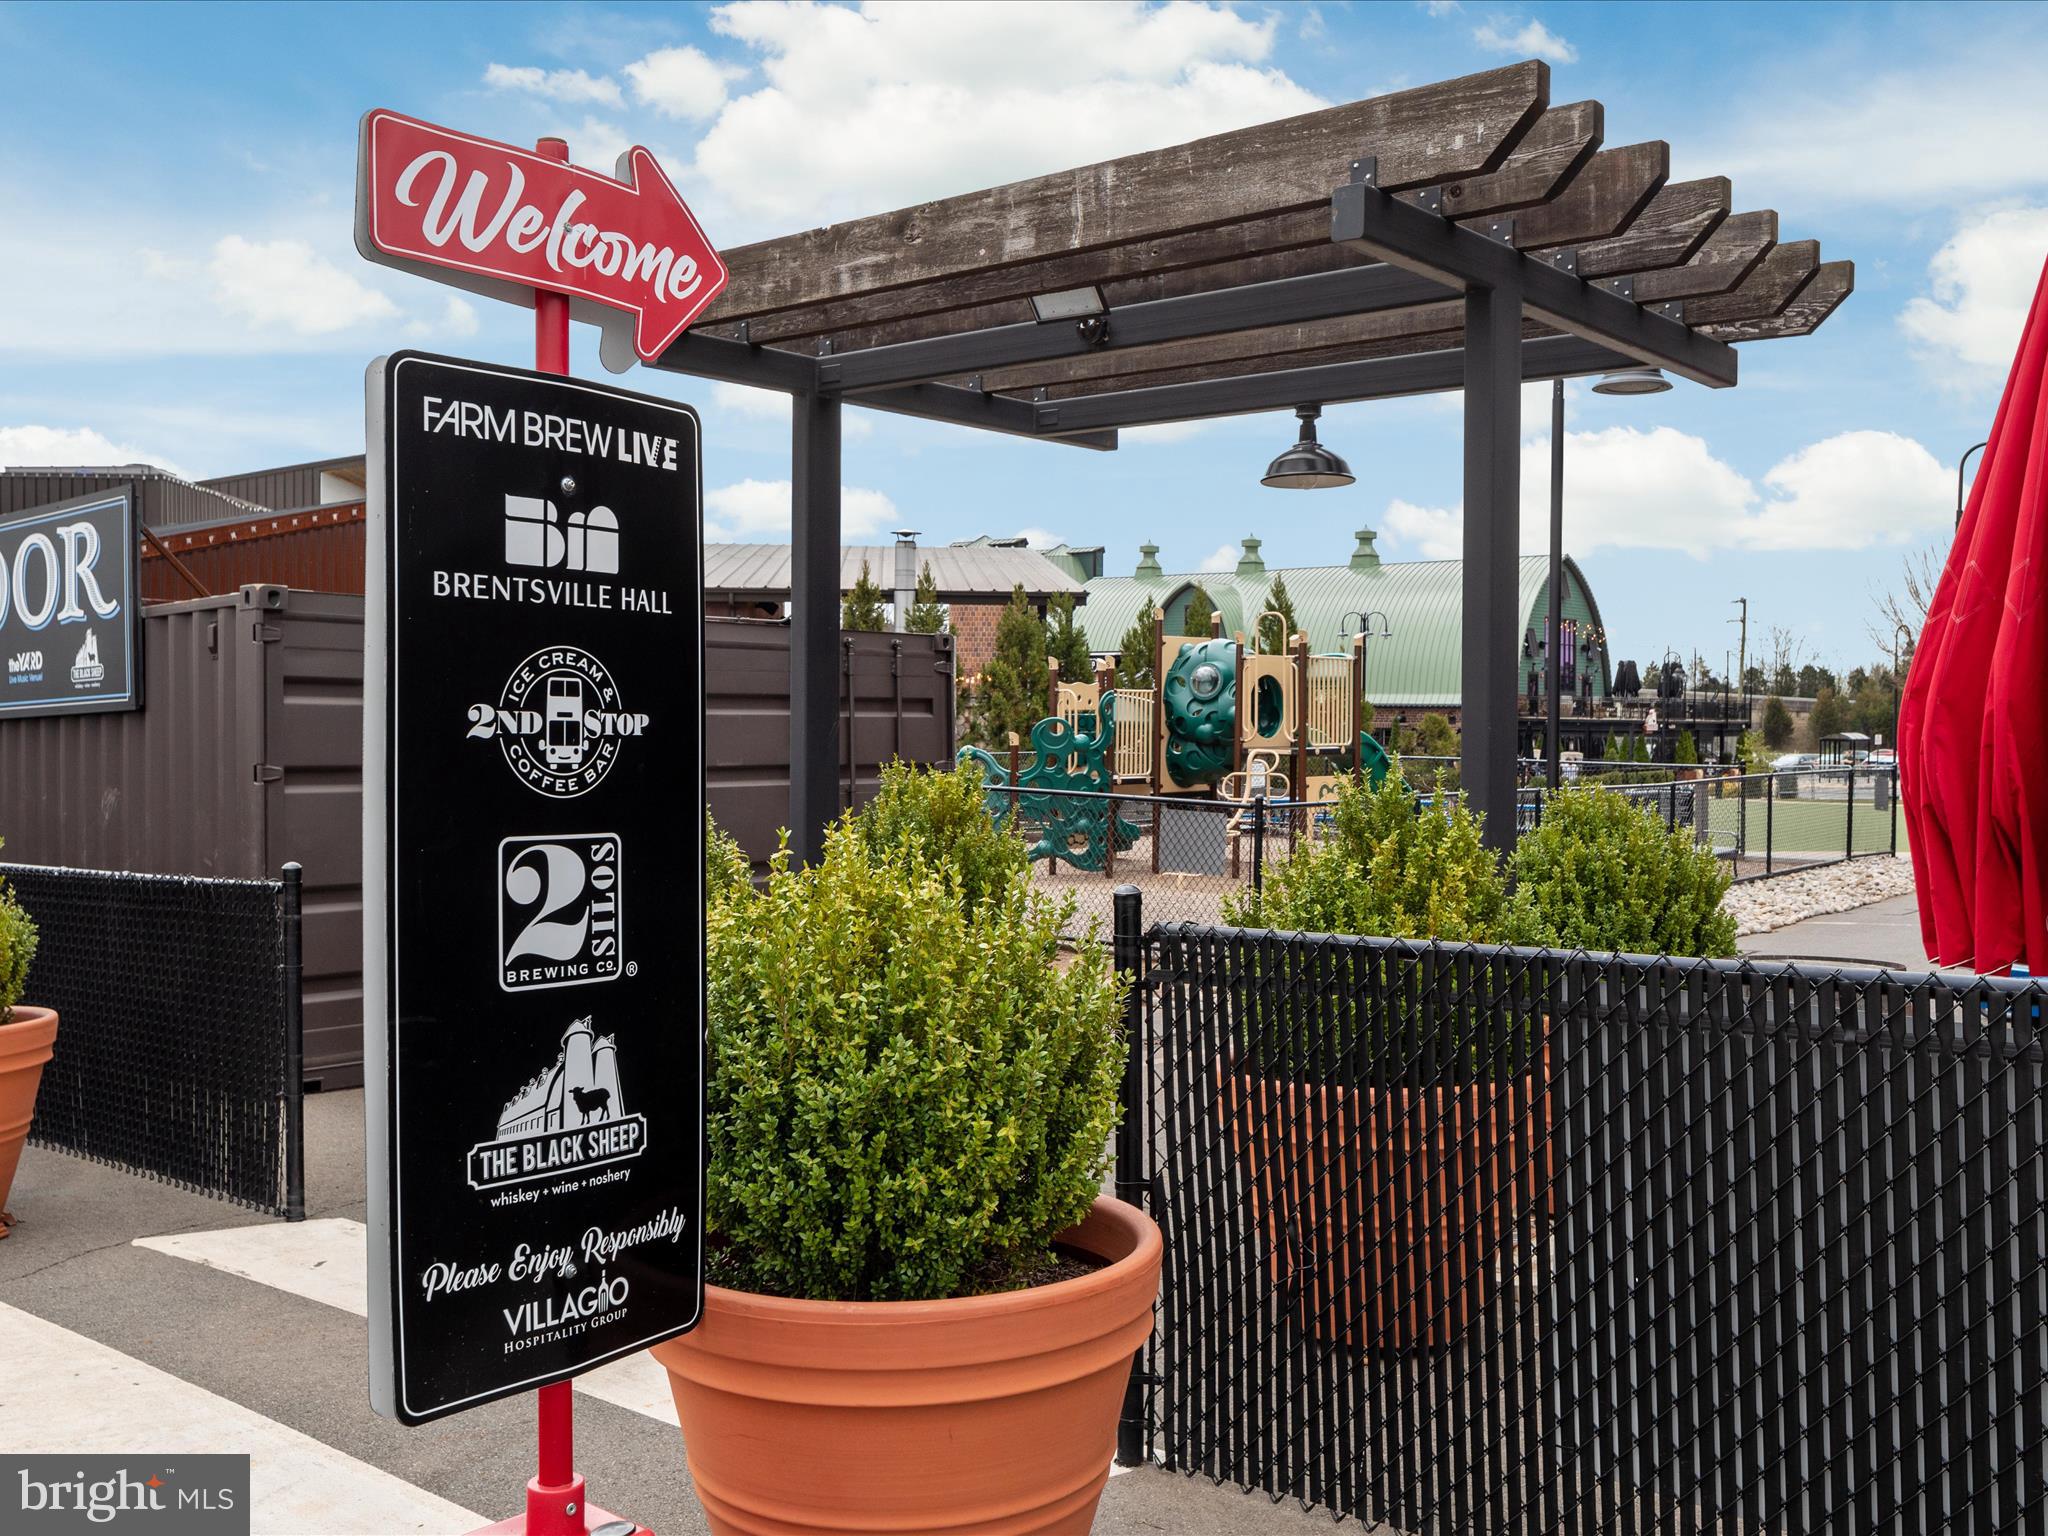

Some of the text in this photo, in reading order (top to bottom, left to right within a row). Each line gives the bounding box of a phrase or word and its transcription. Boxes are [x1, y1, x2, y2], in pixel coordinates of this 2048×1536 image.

[395, 151, 702, 303] Welcome
[423, 396, 677, 471] FARM BREW LIVE
[0, 521, 120, 631] OR
[433, 571, 672, 614] BRENTSVILLE HALL
[508, 666, 534, 702] ICE
[538, 652, 604, 683] CREAM
[466, 703, 650, 739] 2ND STOP
[510, 742, 615, 792] COFFEE BAR
[505, 844, 590, 967] 2
[591, 842, 616, 957] SILOS
[506, 963, 589, 983] BREWING
[479, 1122, 640, 1180] THE BLACK SHEEP
[490, 1188, 540, 1208] whiskey
[552, 1180, 579, 1195] wine
[589, 1168, 631, 1187] noshery
[421, 1206, 687, 1302] Please Enjoy Responsibly
[504, 1306, 629, 1354] HOSPITALITY GROUP
